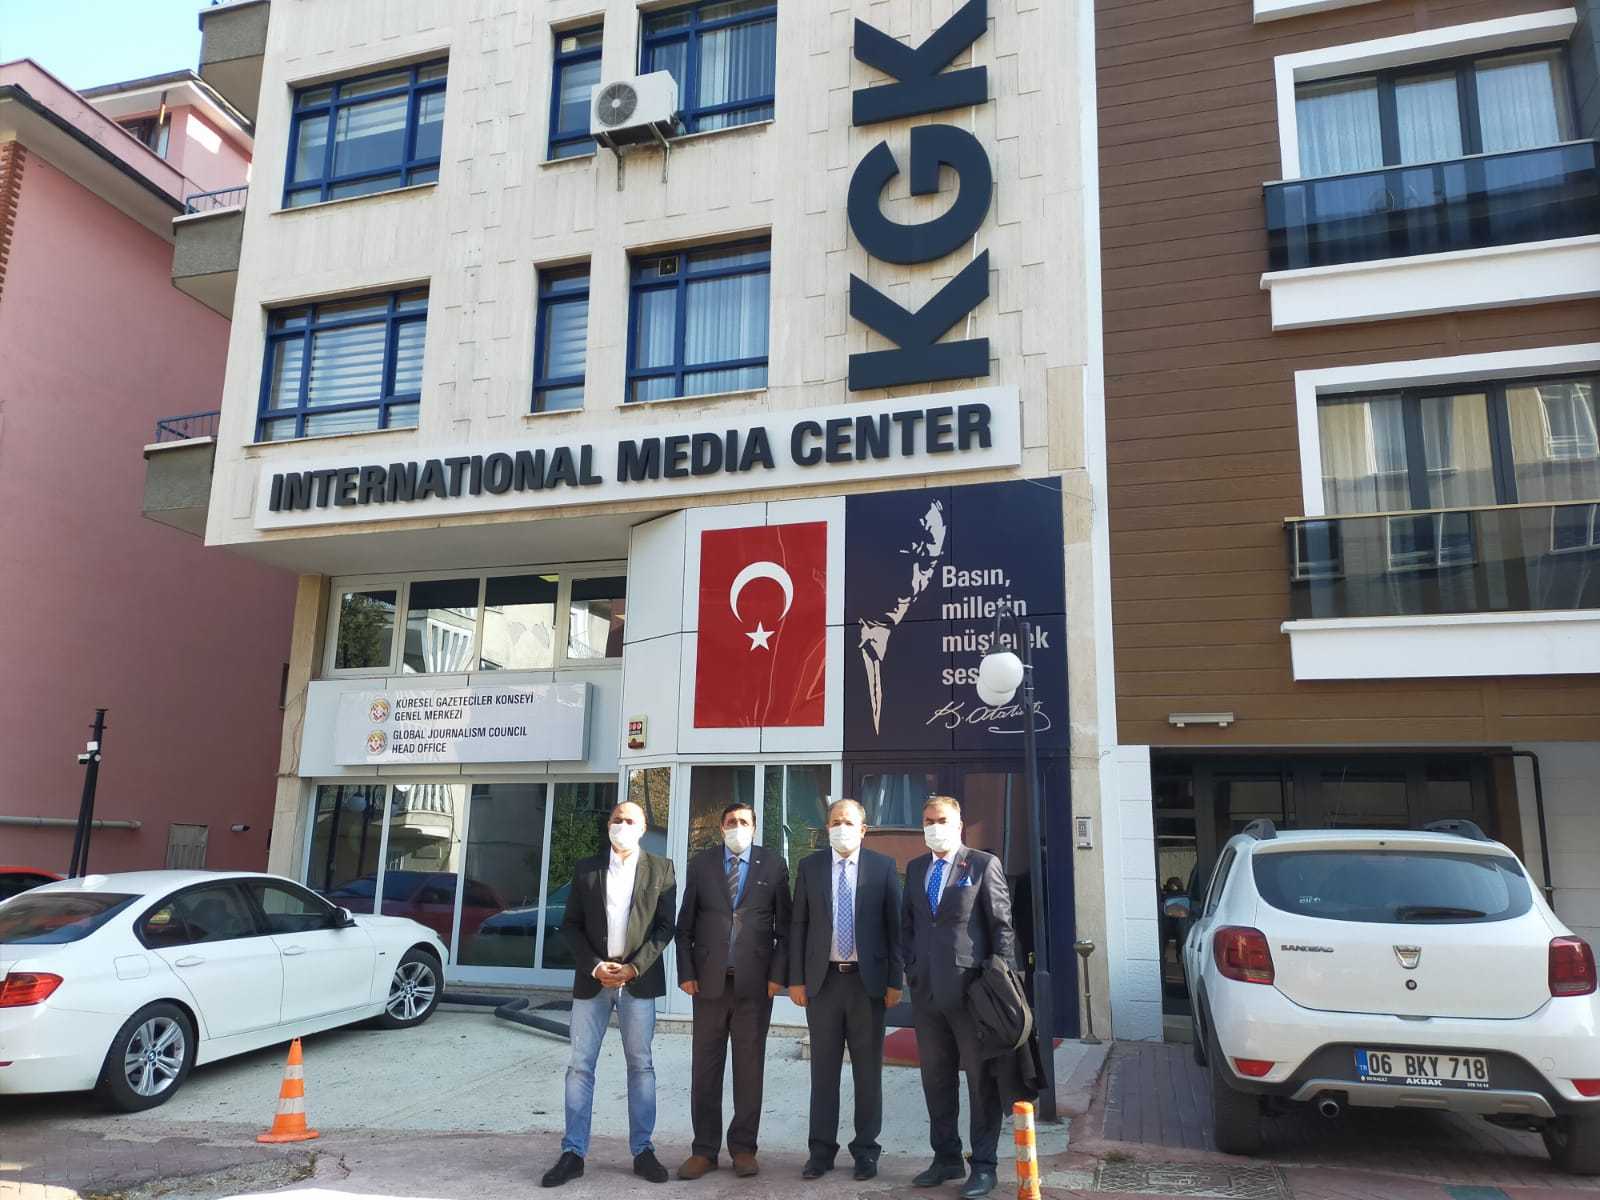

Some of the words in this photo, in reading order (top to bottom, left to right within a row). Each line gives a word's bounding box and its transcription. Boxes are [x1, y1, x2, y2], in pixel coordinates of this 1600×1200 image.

[847, 0, 993, 391] KGK
[268, 444, 603, 512] INTERNATIONAL
[616, 426, 776, 483] MEDIA
[790, 402, 993, 467] CENTER
[942, 565, 1011, 588] Basın,
[942, 594, 1027, 620] milletin
[942, 625, 1050, 658] müştek
[395, 696, 433, 709] KÜRESEL
[436, 694, 493, 708] GAZETECİLER
[495, 692, 534, 705] KONSEYİ
[394, 711, 422, 722] GENEL
[424, 709, 463, 720] MERKEZİ
[393, 729, 425, 740] GLOBAL
[427, 727, 486, 739] JOURNALISM
[488, 726, 528, 737] COUNCIL
[391, 743, 415, 754] HEAD
[417, 742, 447, 753] OFFICE
[1368, 1053, 1393, 1074] 06
[1404, 1055, 1439, 1077] BKY
[1448, 1056, 1486, 1080] 718
